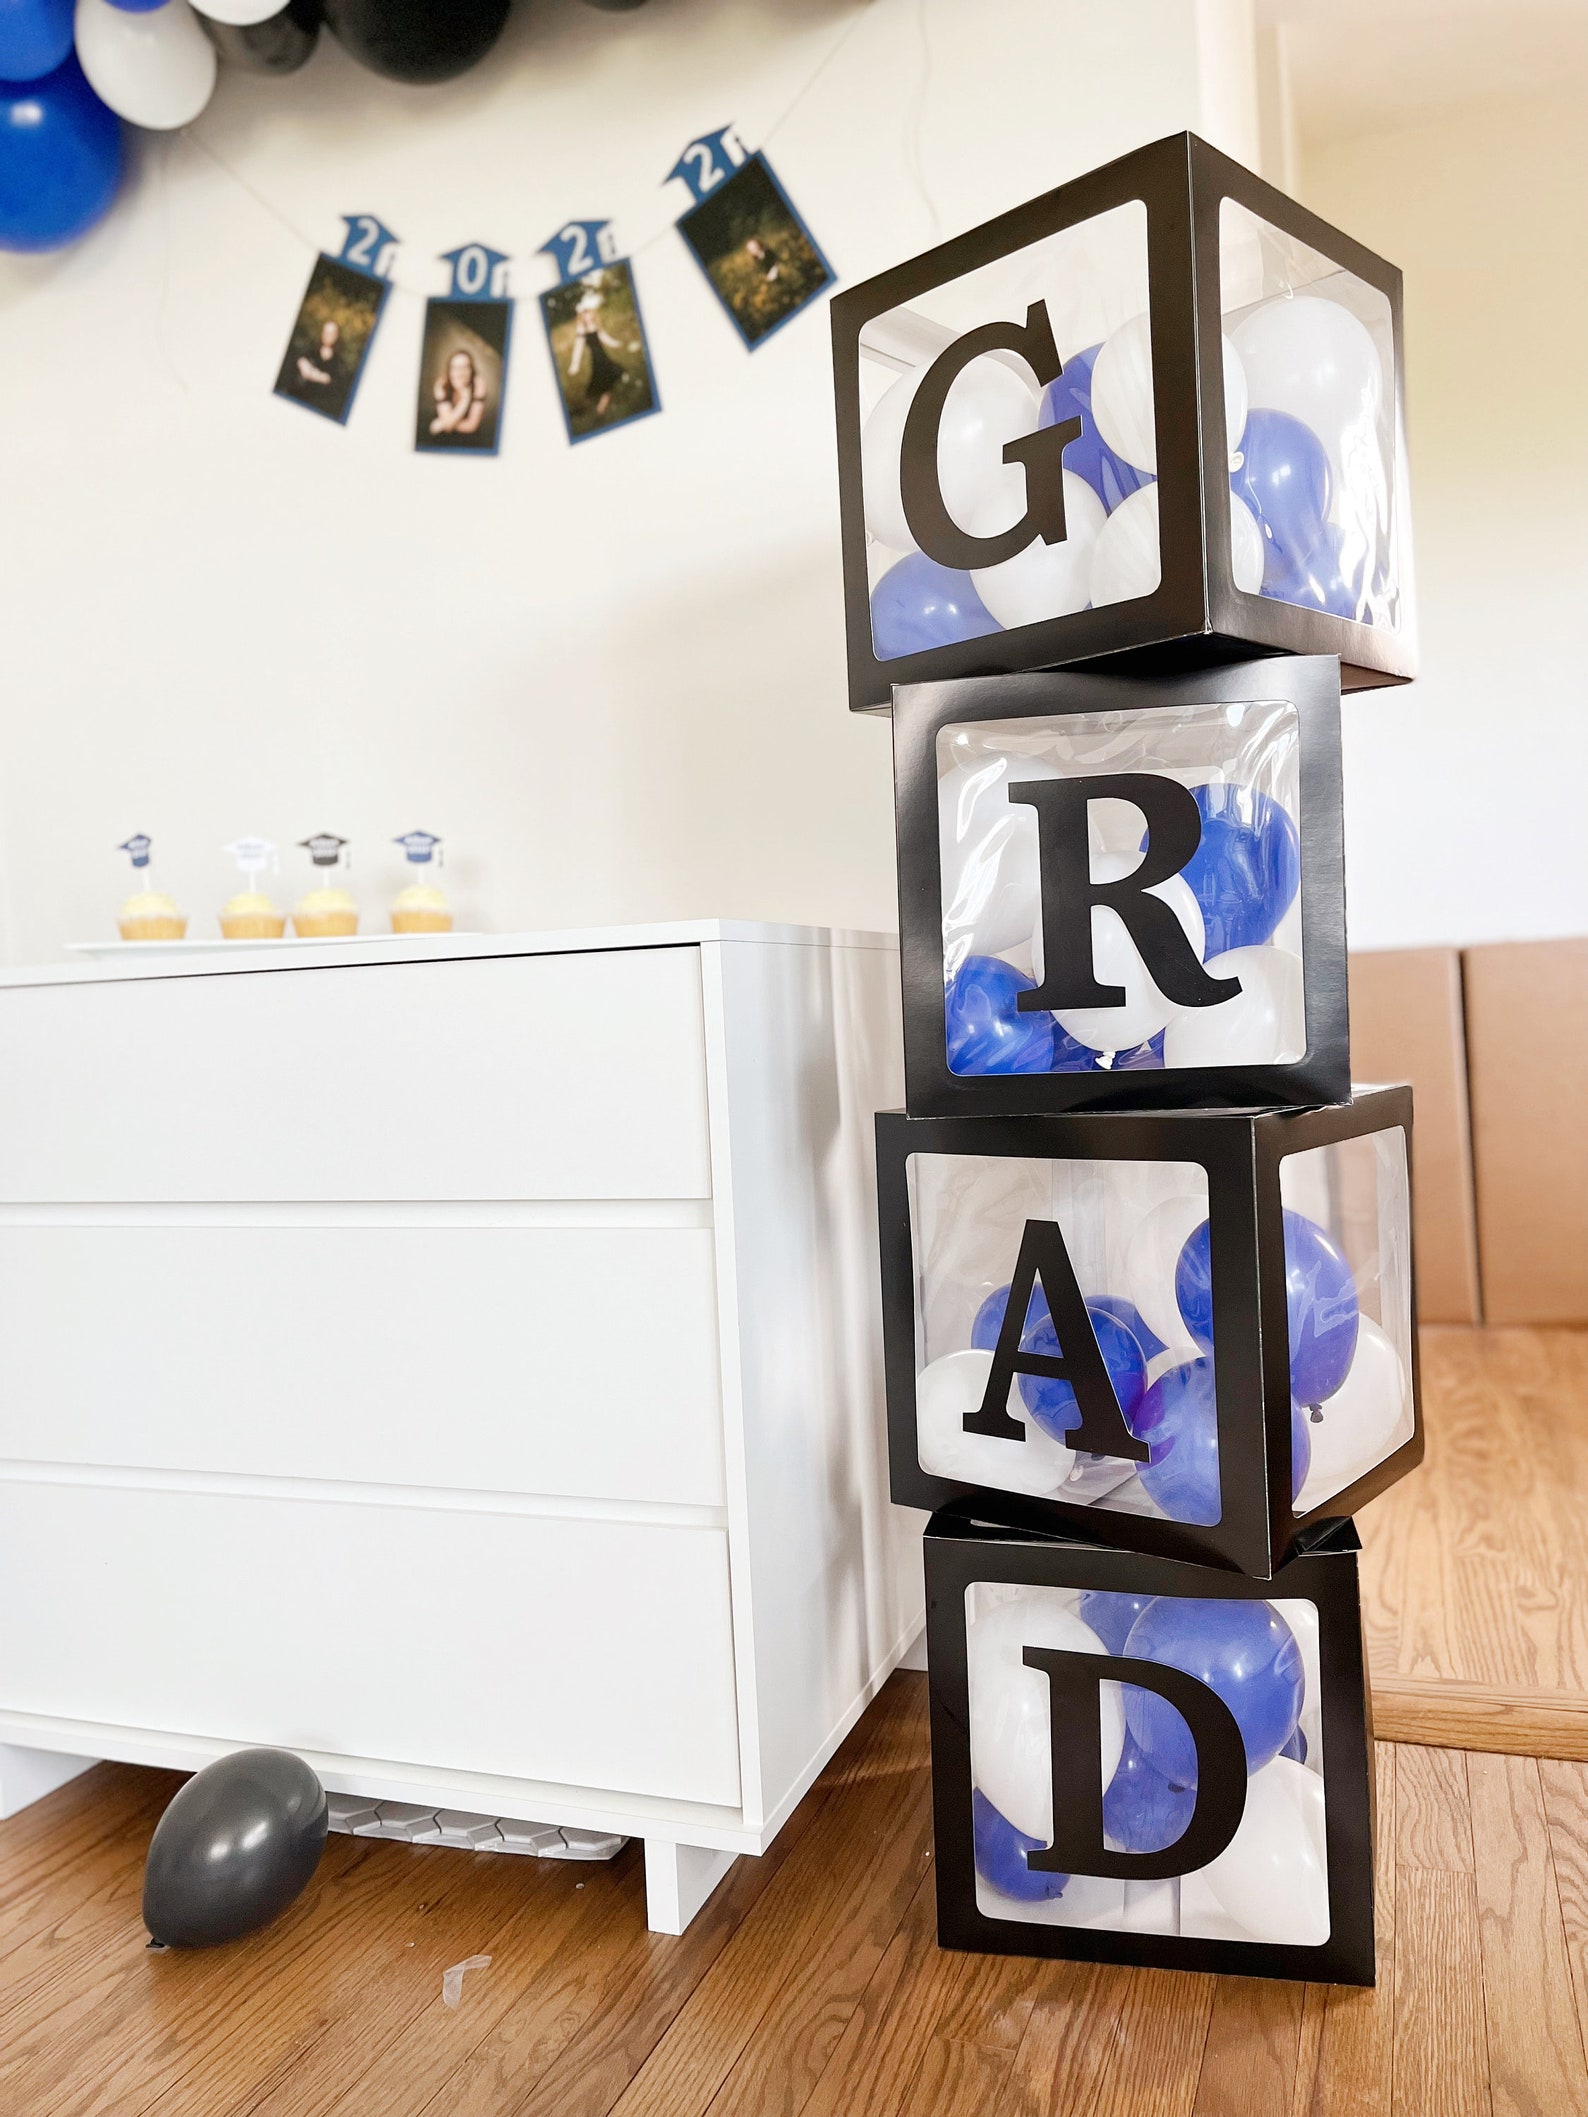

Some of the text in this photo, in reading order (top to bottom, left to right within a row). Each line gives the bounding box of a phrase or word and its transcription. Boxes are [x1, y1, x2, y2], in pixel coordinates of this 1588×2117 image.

[346, 143, 725, 295] 2 0 2 2
[899, 298, 1082, 571] G
[1008, 772, 1243, 1013] R
[962, 1218, 1151, 1463] A
[1022, 1645, 1248, 1881] D
